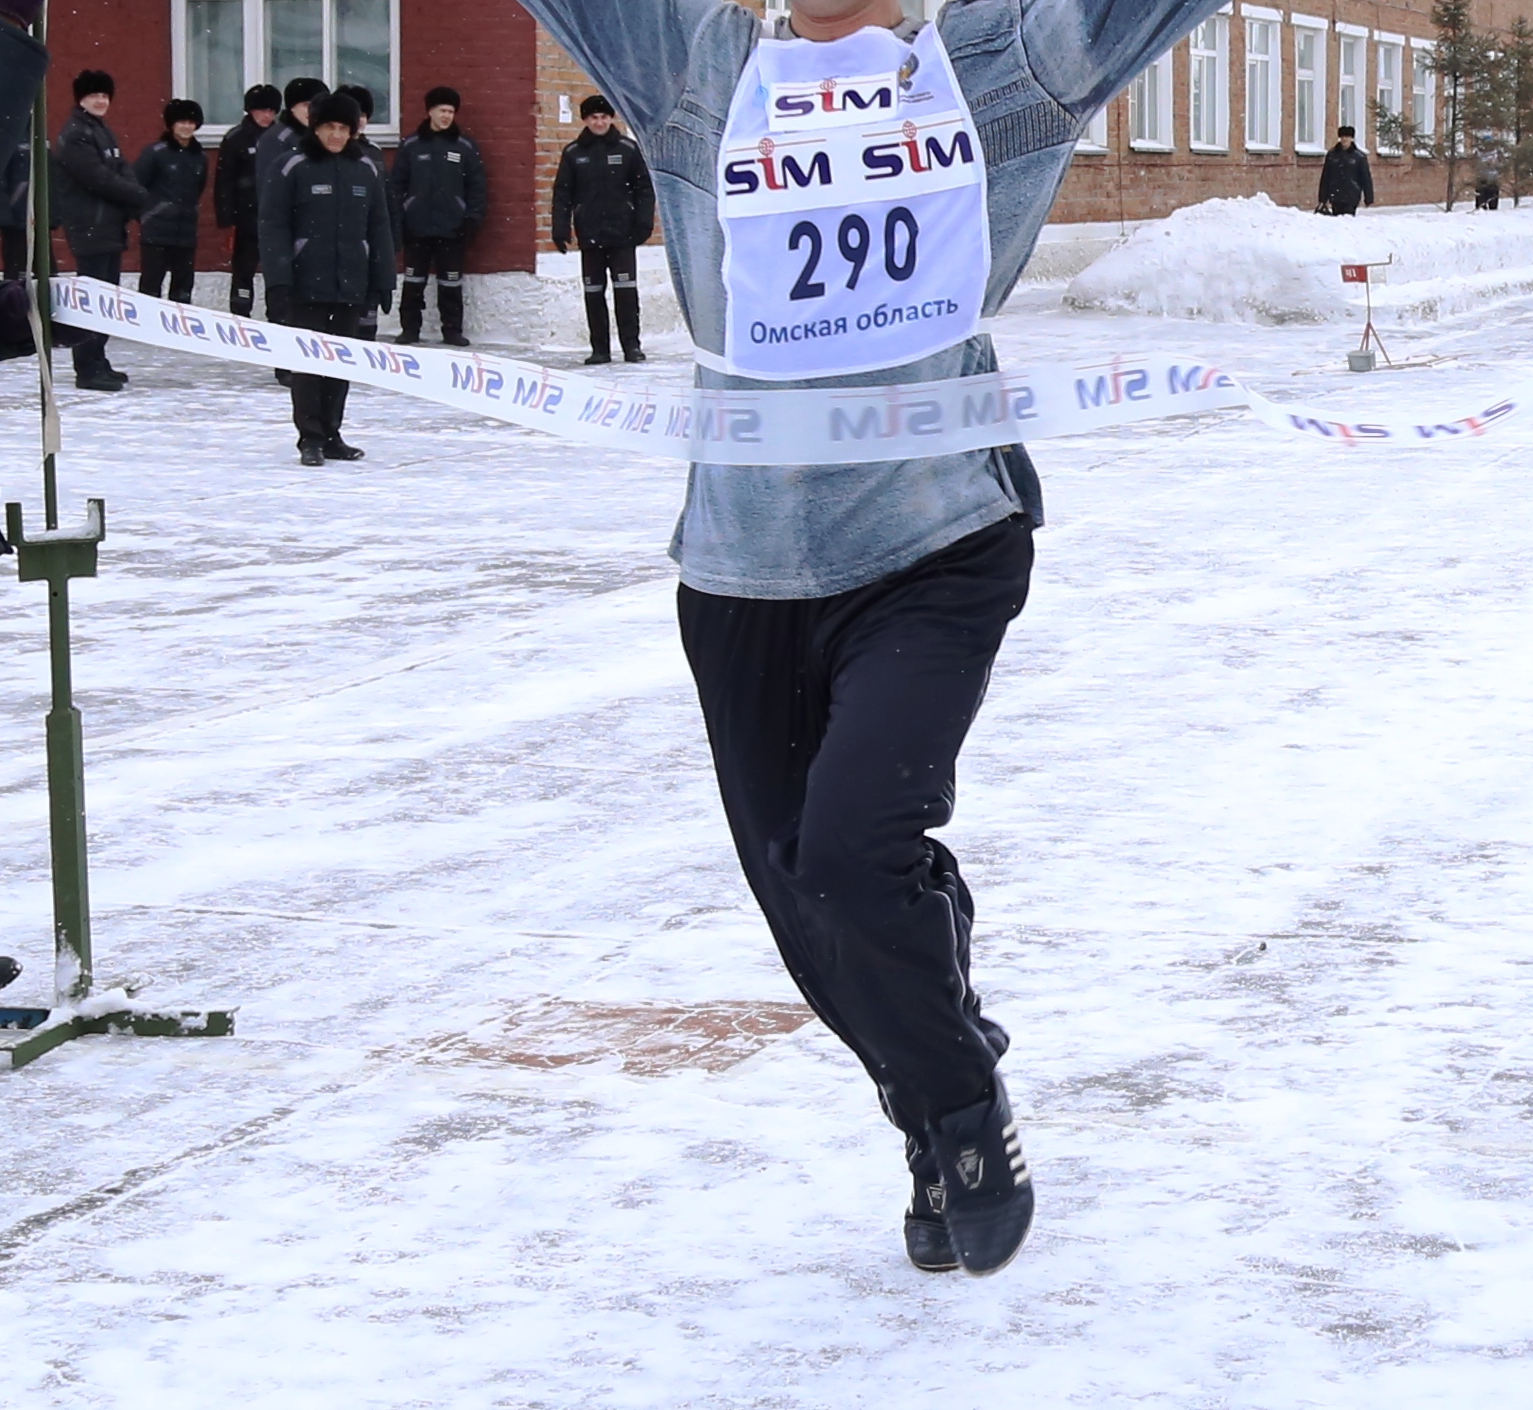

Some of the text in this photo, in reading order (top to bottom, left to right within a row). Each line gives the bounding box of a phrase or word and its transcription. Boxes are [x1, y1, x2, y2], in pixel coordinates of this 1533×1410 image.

[788, 206, 920, 303] 290
[750, 299, 960, 346] Омская область
